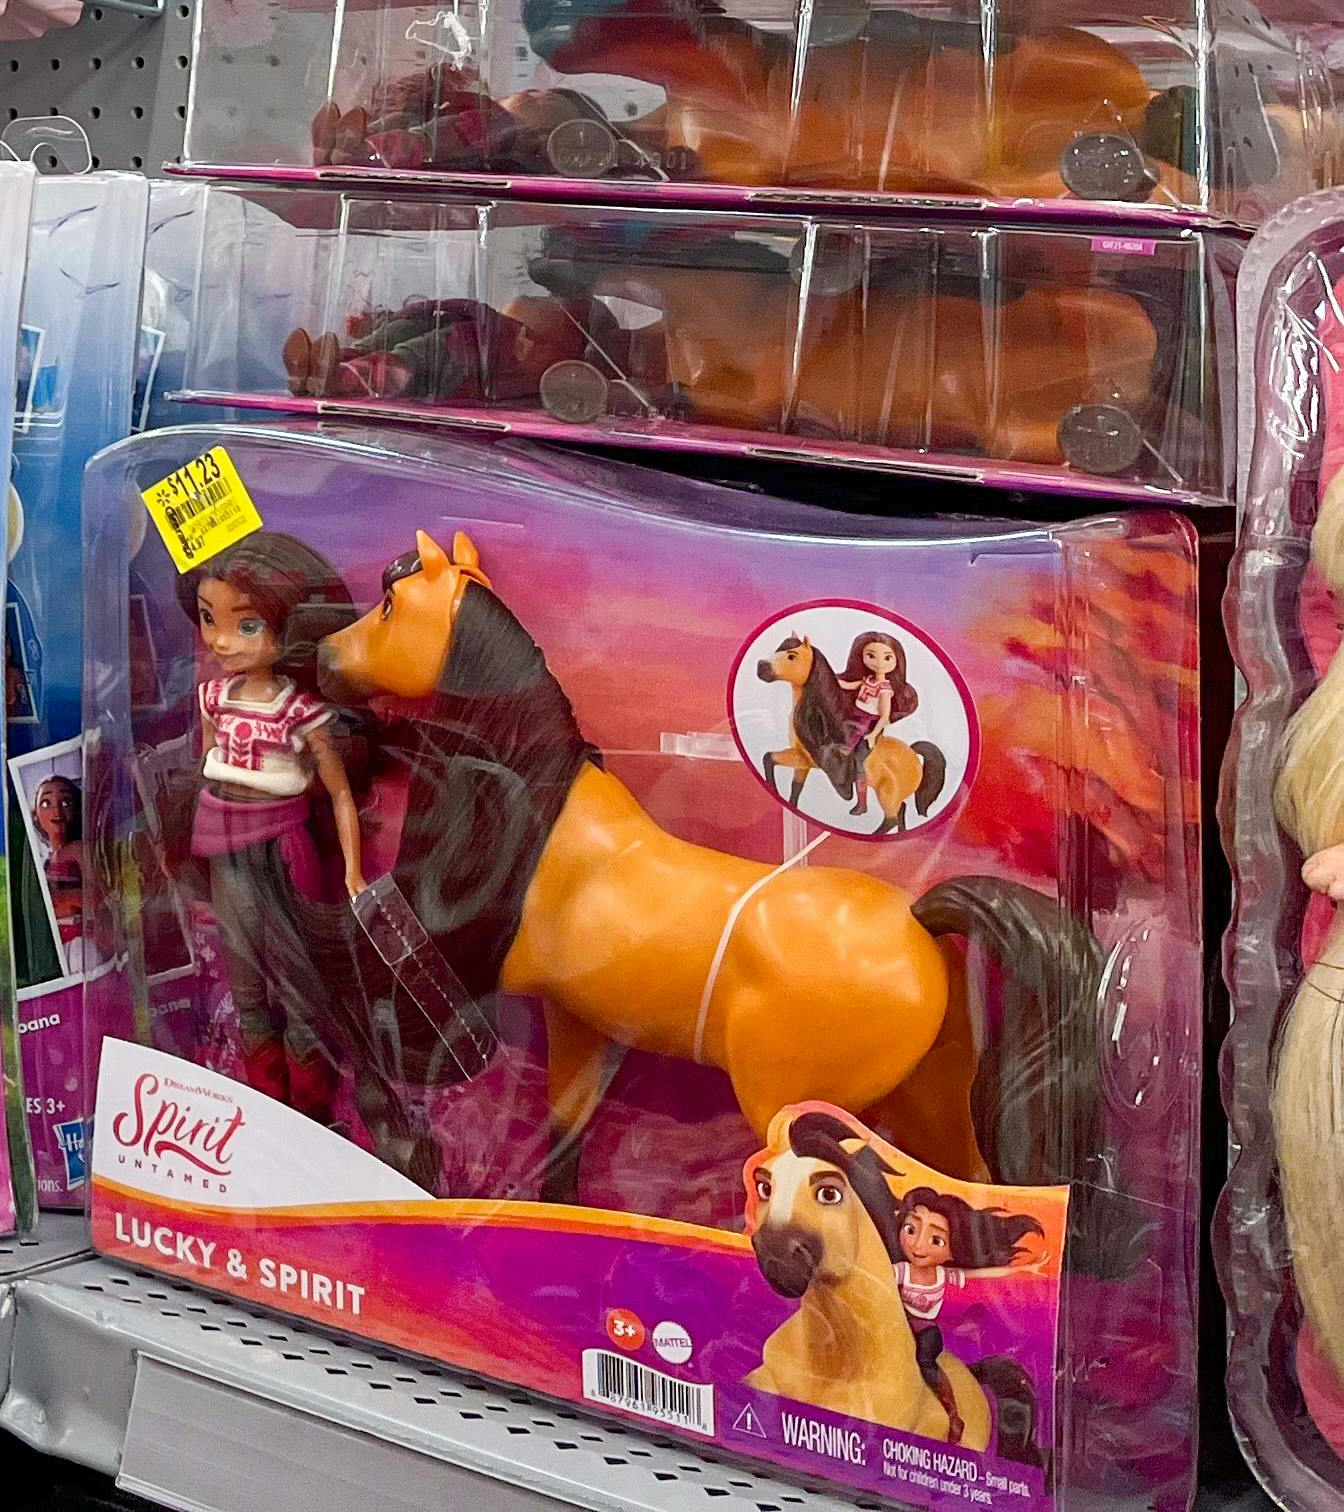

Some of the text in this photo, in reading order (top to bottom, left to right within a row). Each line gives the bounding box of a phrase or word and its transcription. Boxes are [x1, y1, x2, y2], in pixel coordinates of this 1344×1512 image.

[167, 452, 221, 498] $11.23
[17, 1012, 61, 1034] oana
[45, 1096, 66, 1115] 3+
[111, 1072, 247, 1166] Spirit
[117, 1154, 228, 1194] UNTAMED
[114, 1212, 366, 1316] LUCKY & SPIRIT
[613, 1319, 637, 1338] 3+
[653, 1337, 693, 1349] MATTEL
[780, 1411, 867, 1468] WARNING:
[882, 1437, 1032, 1499] CHOKING HAZARD Small parts.
[882, 1461, 993, 1506] Not for children under 3 years.
